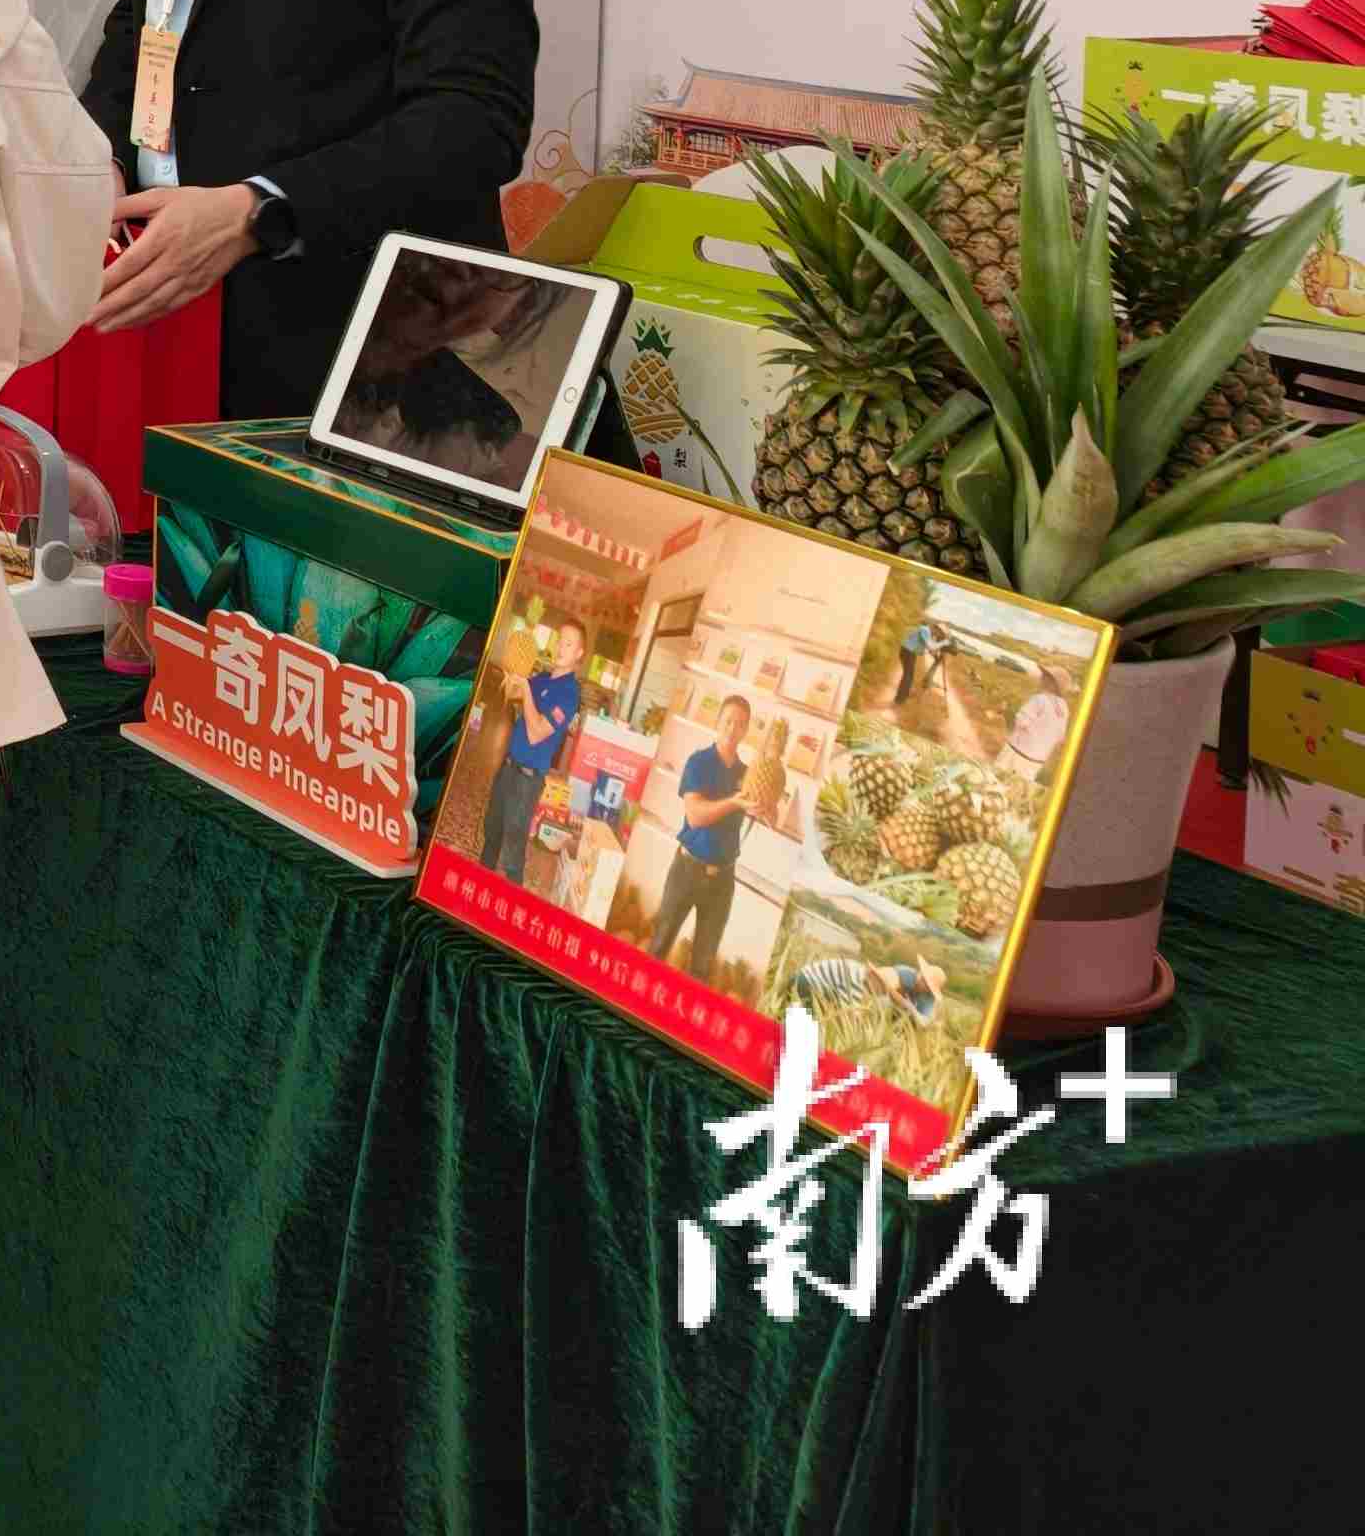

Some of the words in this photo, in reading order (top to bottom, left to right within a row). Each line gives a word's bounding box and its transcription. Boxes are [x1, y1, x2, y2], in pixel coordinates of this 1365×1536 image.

[151, 691, 167, 721] A
[172, 702, 262, 771] Strange
[268, 749, 401, 845] Pineapple
[152, 621, 400, 798] 一奇凤梨
